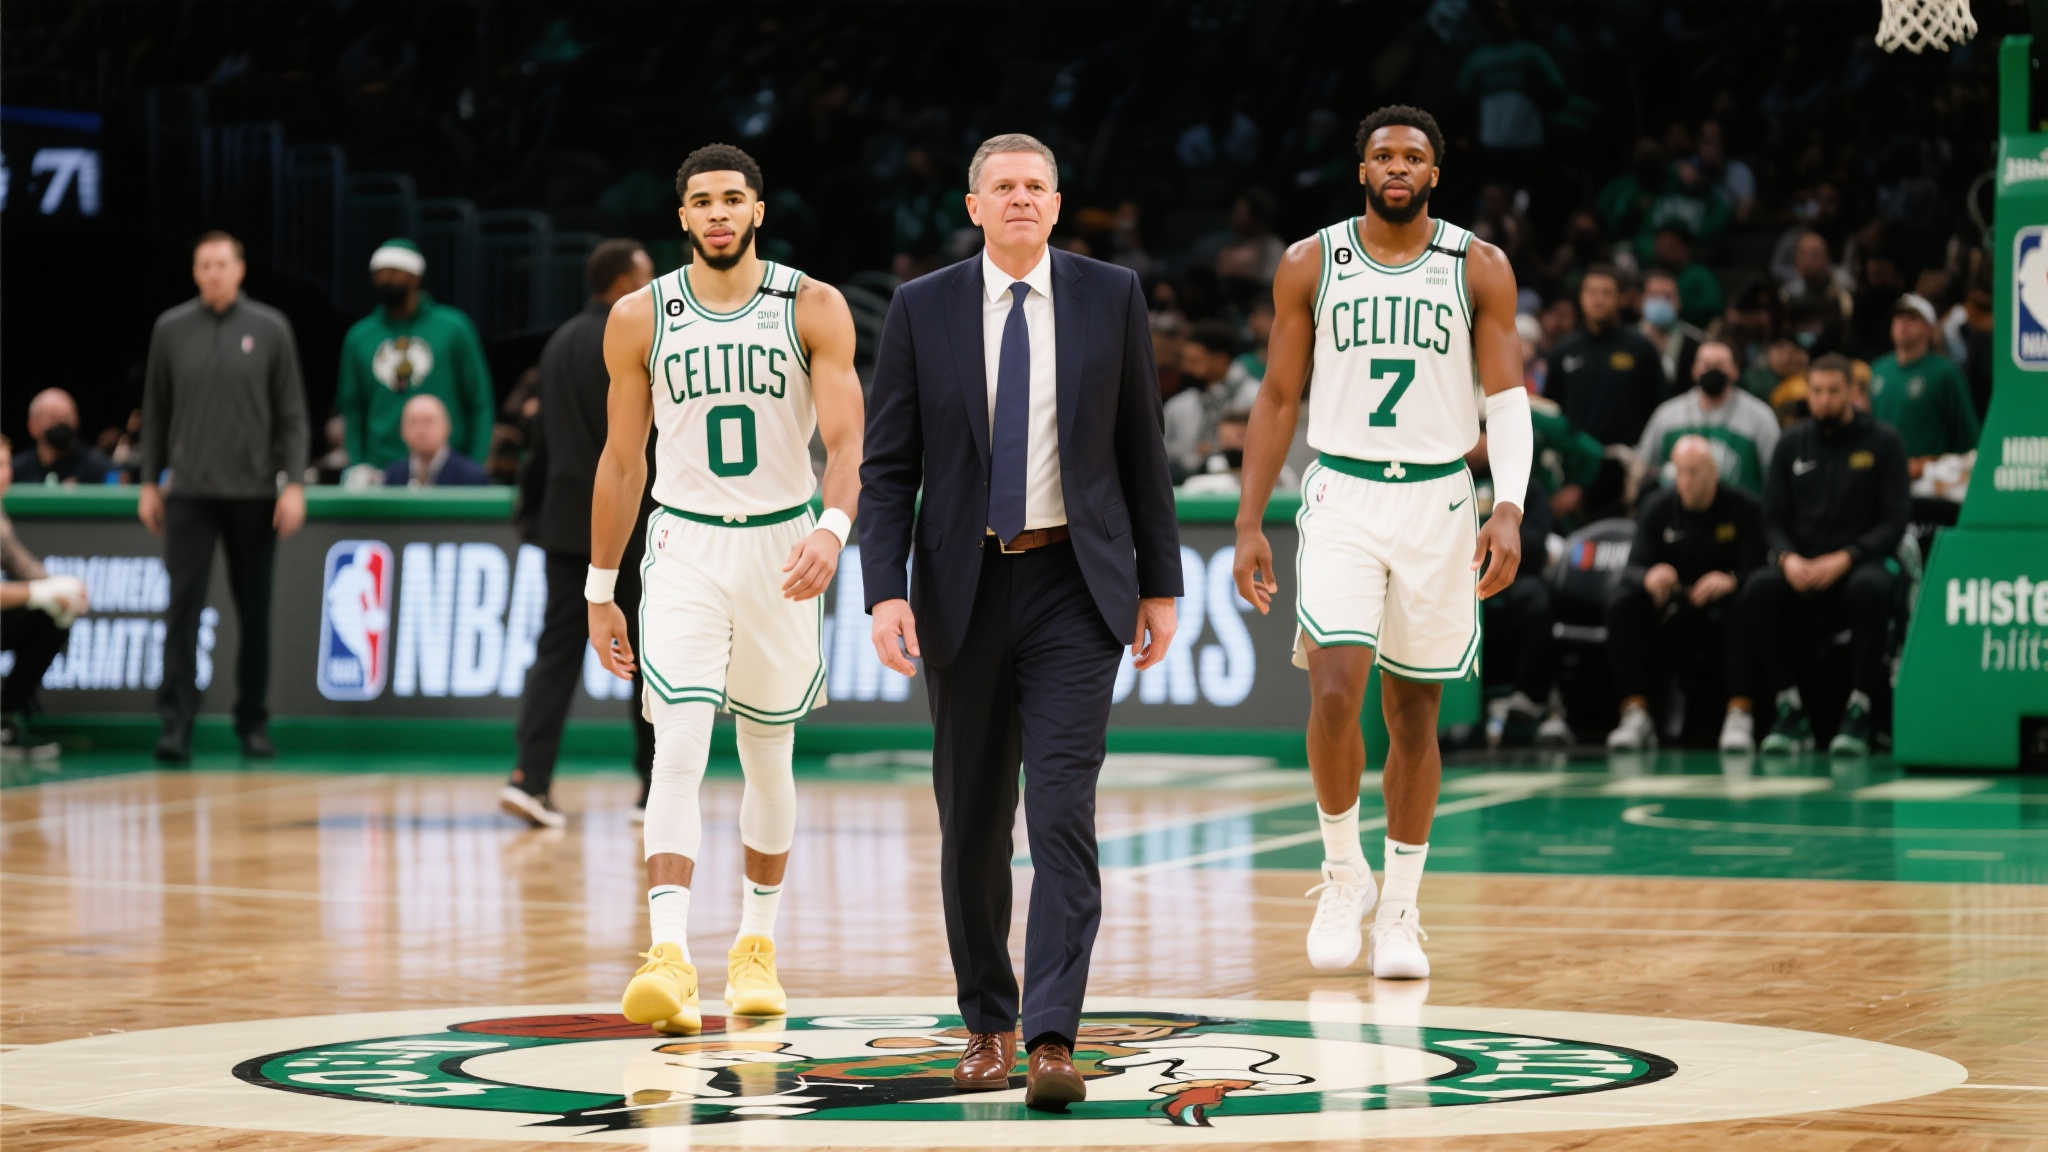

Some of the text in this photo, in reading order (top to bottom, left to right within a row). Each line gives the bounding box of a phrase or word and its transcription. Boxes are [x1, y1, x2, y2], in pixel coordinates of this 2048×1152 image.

[1332, 296, 1453, 354] CELTICS
[663, 344, 787, 404] CELTICS
[1369, 358, 1416, 427] 7
[706, 404, 758, 478] 0
